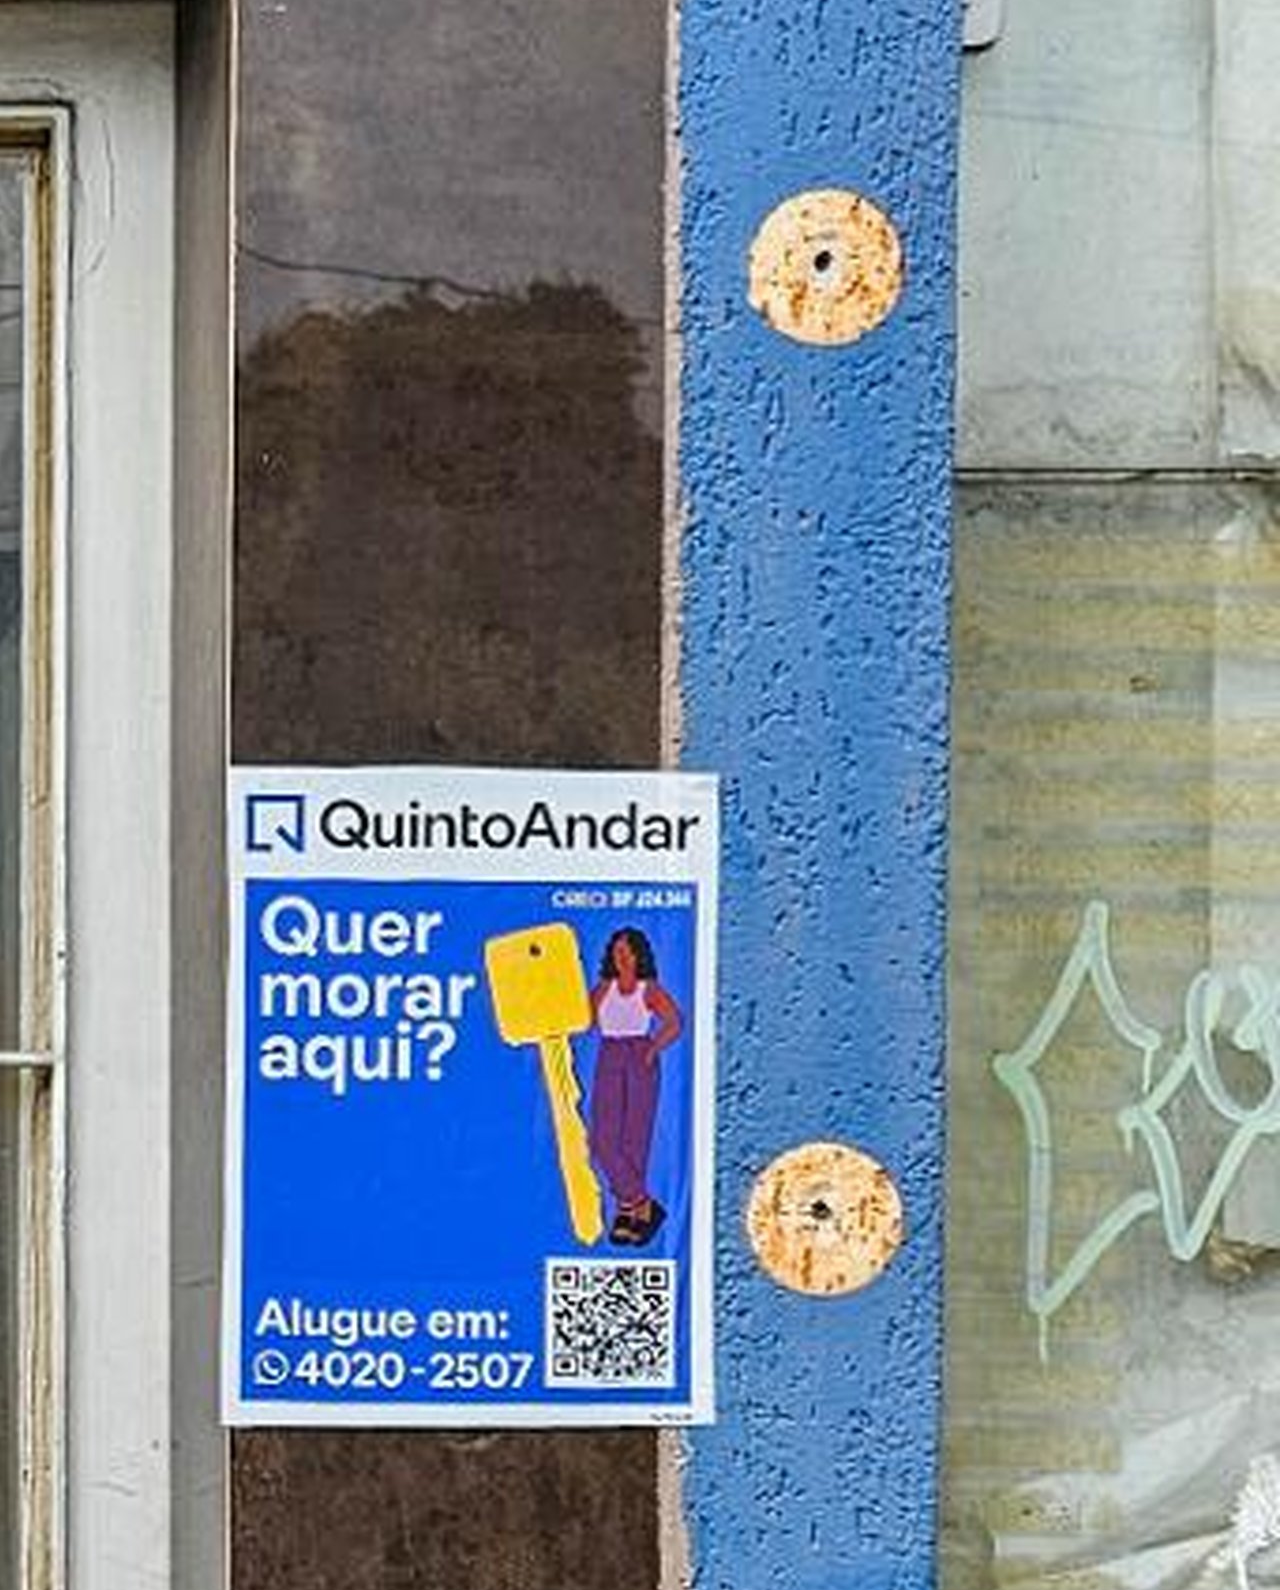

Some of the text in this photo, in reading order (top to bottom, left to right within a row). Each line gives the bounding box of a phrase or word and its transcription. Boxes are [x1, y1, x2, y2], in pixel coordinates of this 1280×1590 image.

[320, 799, 700, 850] QuintoAndar
[260, 894, 443, 957] Quer
[260, 974, 476, 1020] morar
[260, 1021, 457, 1095] aqui?
[255, 1299, 509, 1347] Alugue em:
